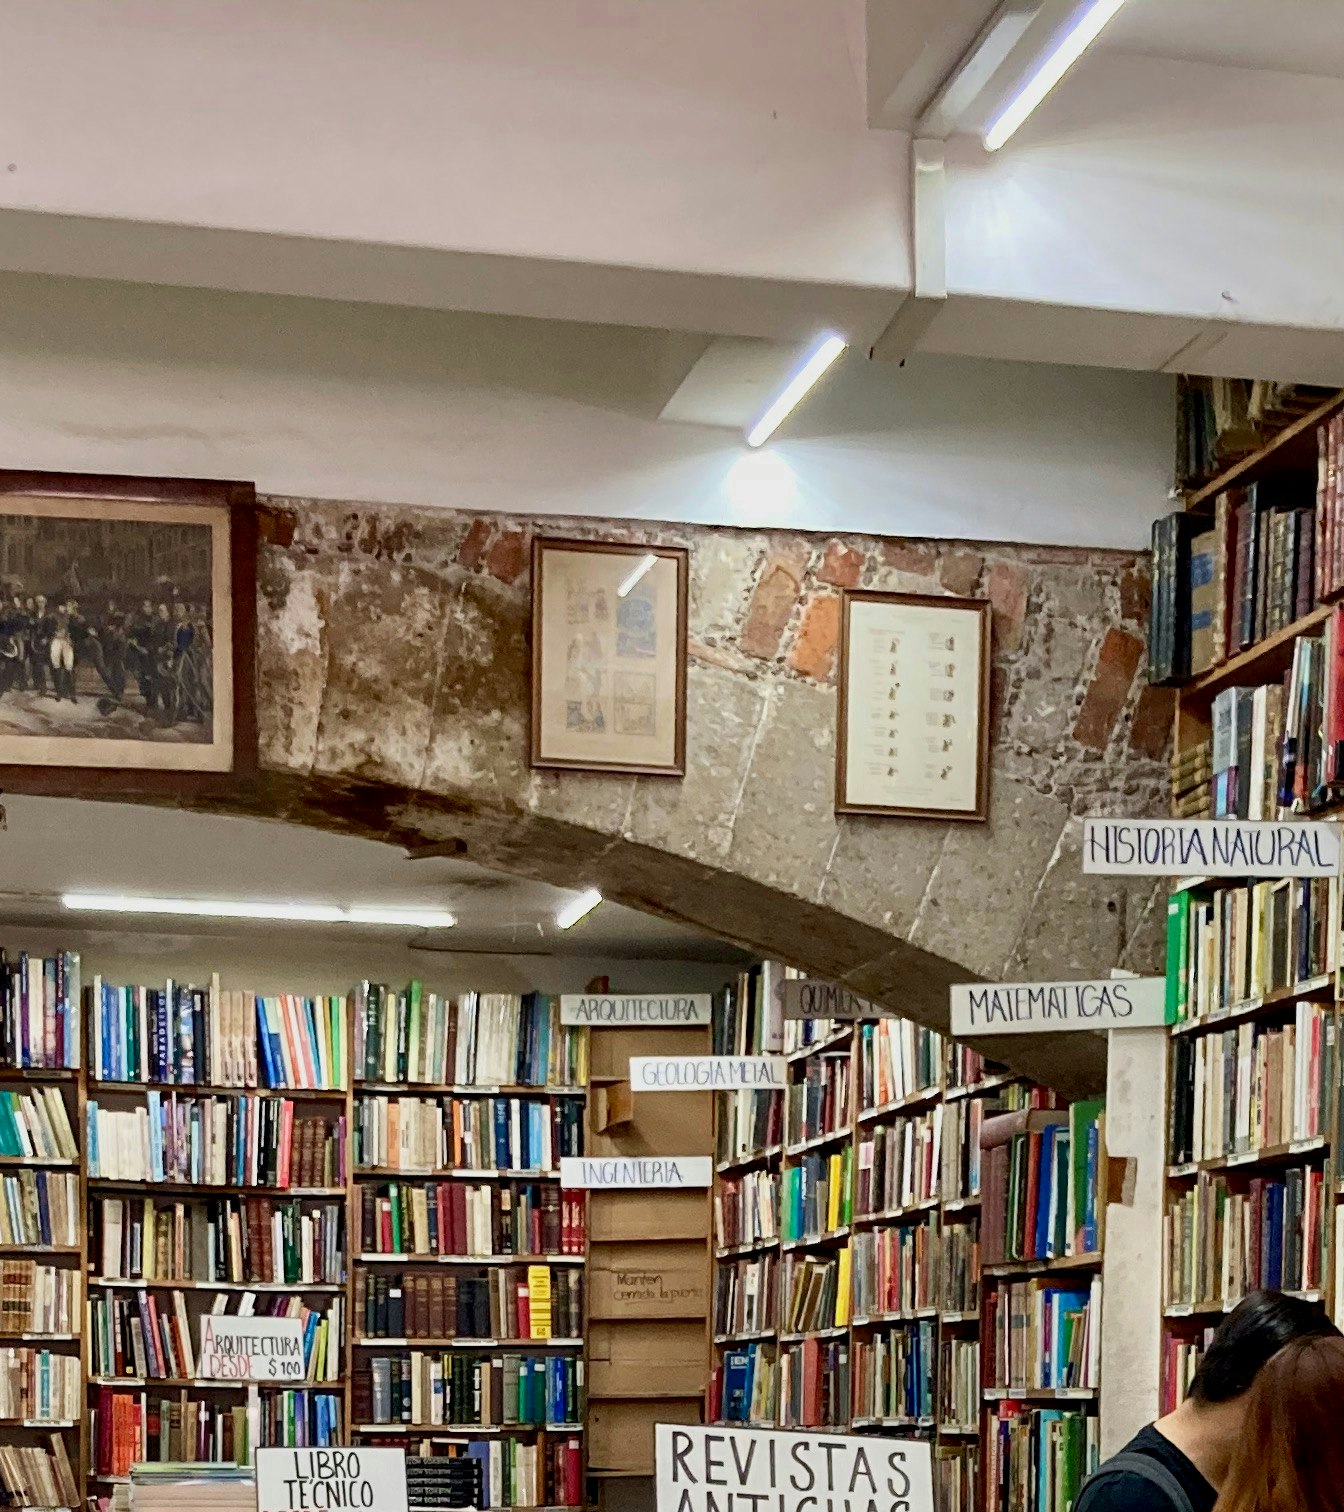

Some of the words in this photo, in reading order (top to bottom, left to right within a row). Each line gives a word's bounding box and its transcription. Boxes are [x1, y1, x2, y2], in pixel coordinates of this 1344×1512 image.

[1089, 824, 1207, 867] HISTORIA
[1212, 828, 1335, 868] NATURAL
[576, 999, 699, 1023] ARQUITECTURA
[968, 982, 1134, 1026] MATEMATICAS
[203, 1320, 301, 1357] ARQUITECTURA
[209, 1353, 254, 1379] DESDE
[293, 1451, 361, 1480] LIBRO
[671, 1431, 911, 1499] REVISTAS
[283, 1479, 374, 1511] TÉCNICO
